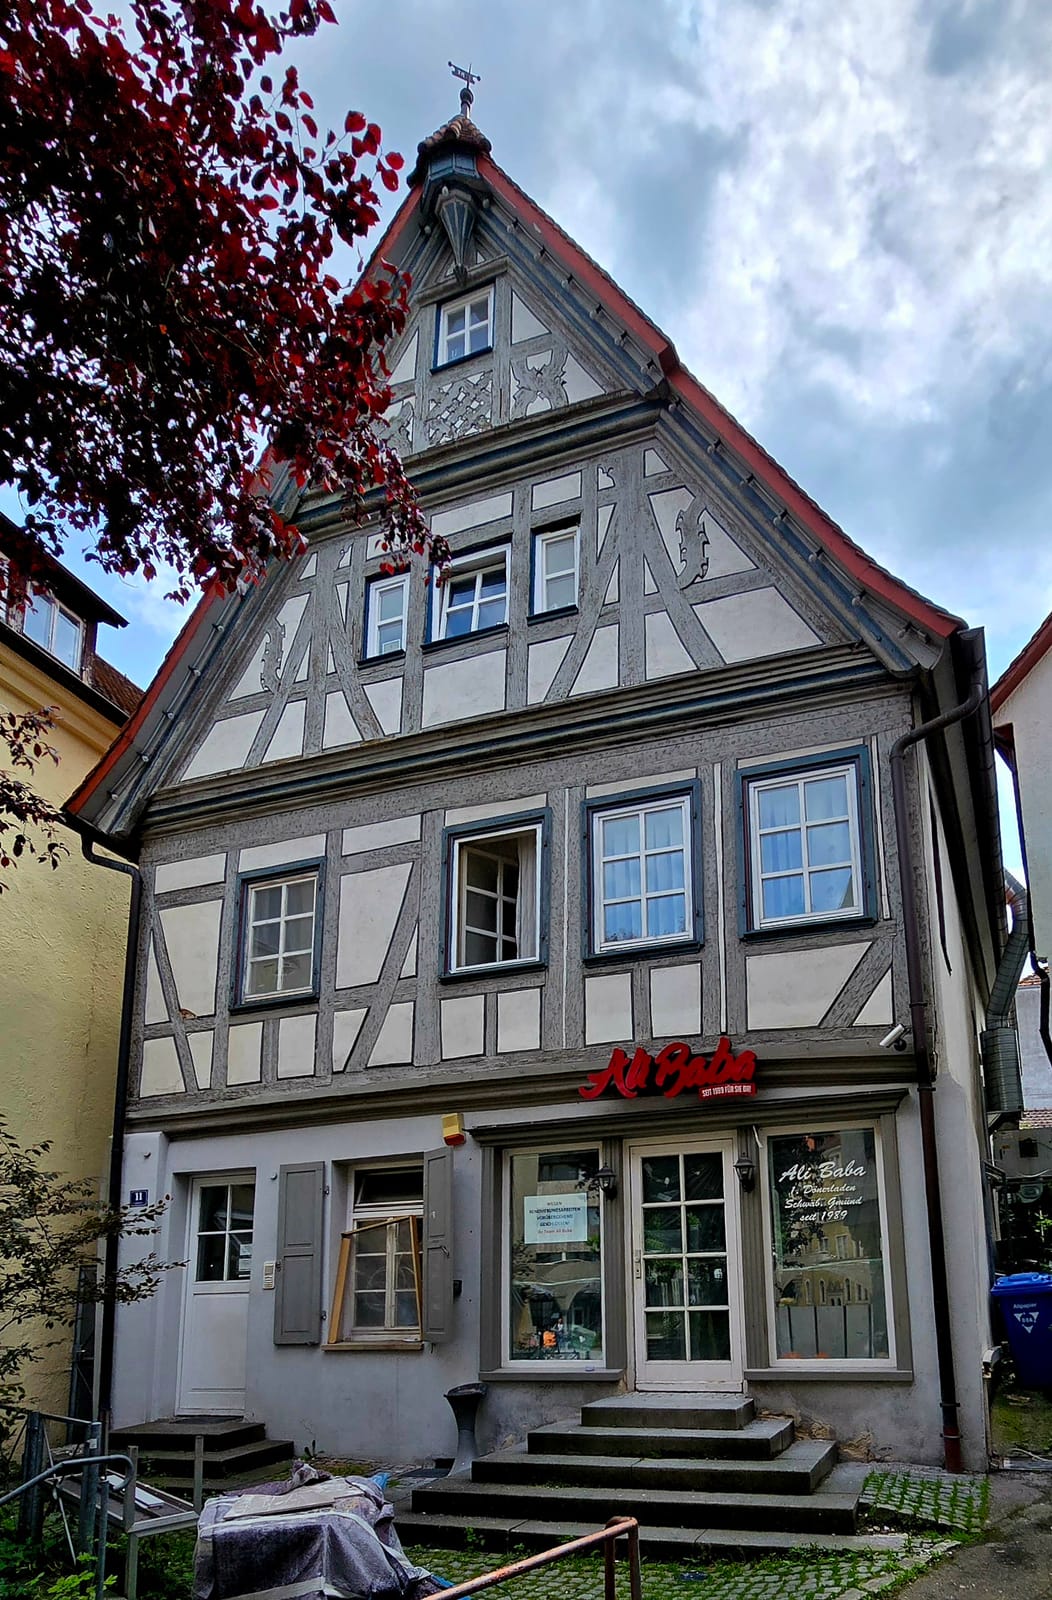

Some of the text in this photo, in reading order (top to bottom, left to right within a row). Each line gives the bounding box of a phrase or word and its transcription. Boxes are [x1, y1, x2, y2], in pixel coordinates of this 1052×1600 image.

[578, 1036, 757, 1098] Ali Baba
[778, 1159, 866, 1182] Ali Baba
[803, 1183, 856, 1194] Dönerladen
[135, 1192, 143, 1201] 11
[827, 1196, 863, 1209] Gmünd
[800, 1210, 848, 1221] seit 1989
